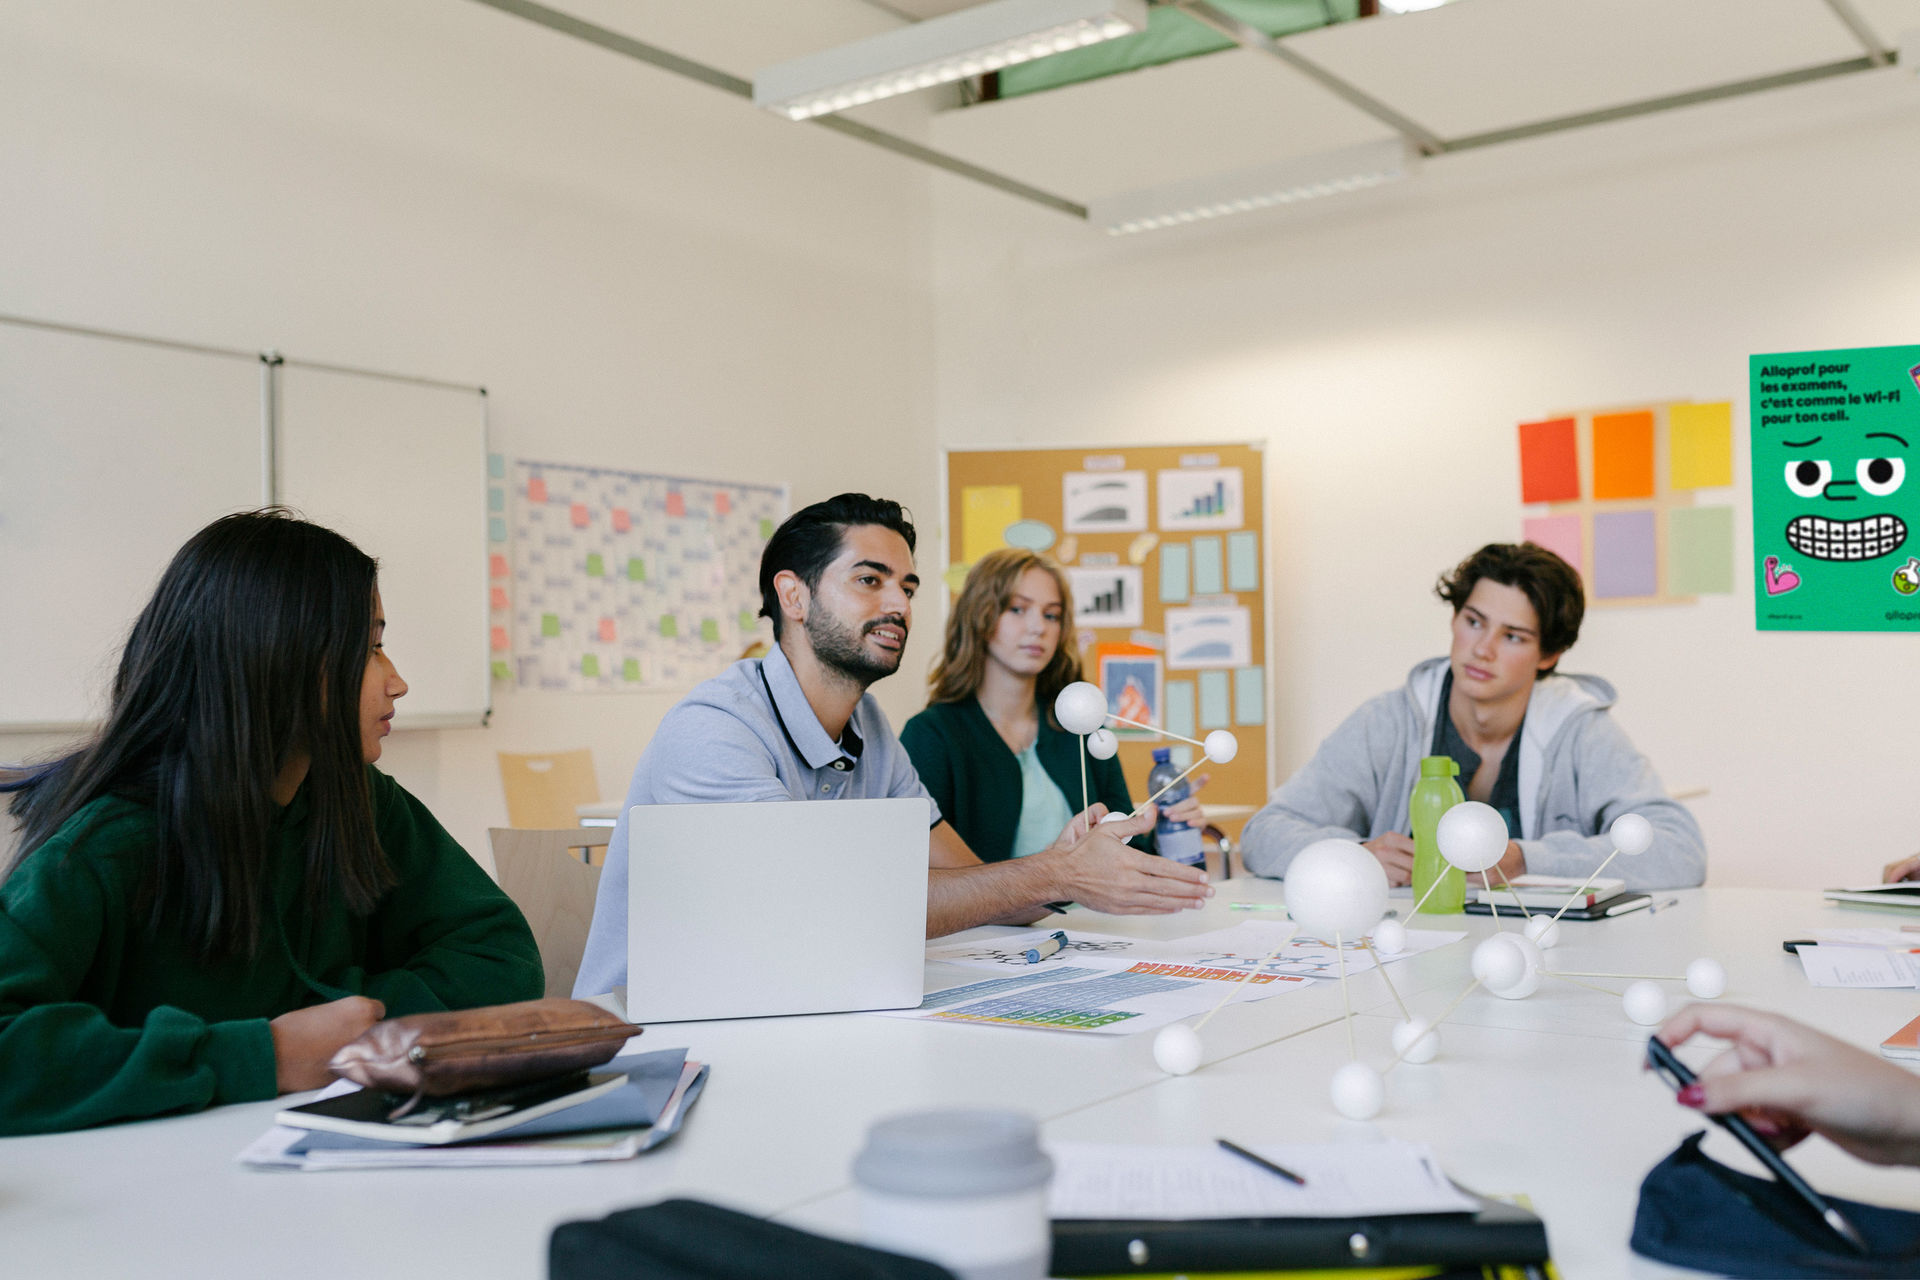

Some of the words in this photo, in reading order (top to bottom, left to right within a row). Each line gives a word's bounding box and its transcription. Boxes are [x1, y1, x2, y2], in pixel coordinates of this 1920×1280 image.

[1760, 364, 1815, 379] Alloprof
[1818, 364, 1850, 377] pour
[1760, 382, 1779, 393] les
[1781, 380, 1847, 392] examens,
[1760, 398, 1793, 409] c'est
[1796, 395, 1846, 407] comme
[1848, 393, 1861, 405] le
[1863, 389, 1900, 404] Wi-Fi
[1761, 414, 1791, 428] pour
[1795, 412, 1818, 423] ton
[1820, 409, 1849, 422] cell.
